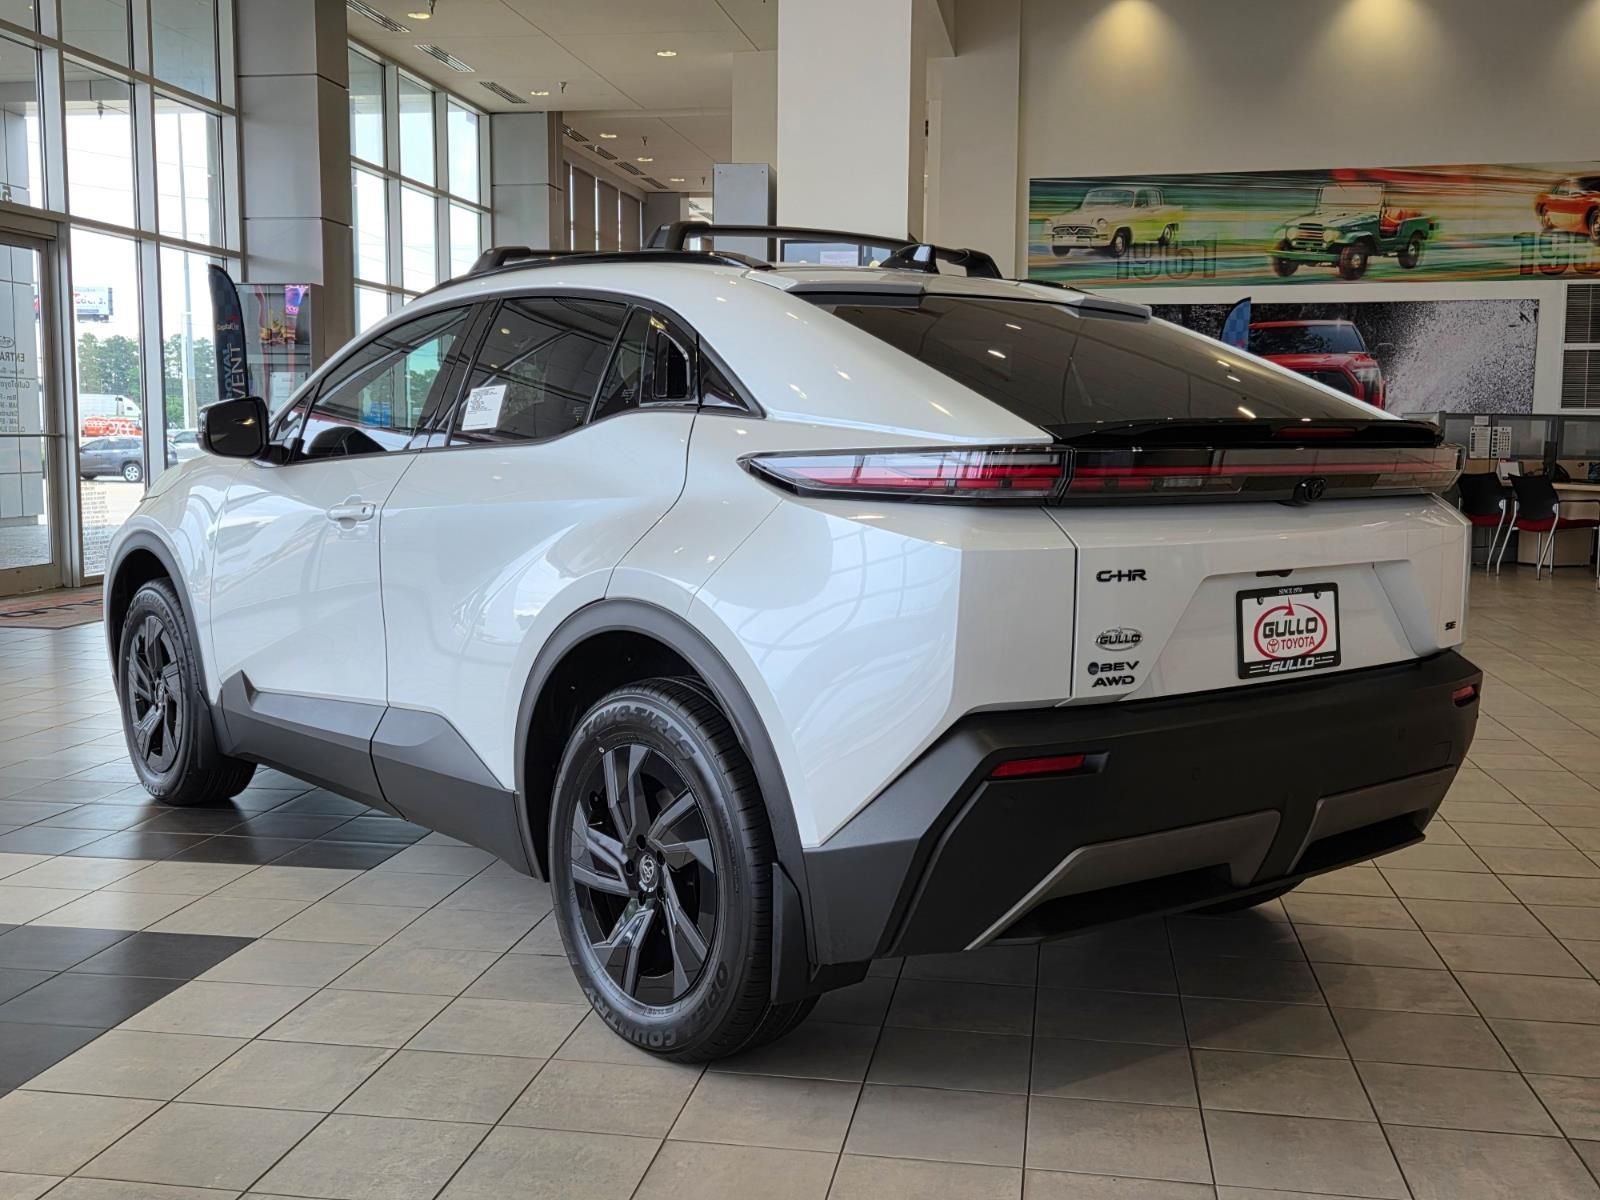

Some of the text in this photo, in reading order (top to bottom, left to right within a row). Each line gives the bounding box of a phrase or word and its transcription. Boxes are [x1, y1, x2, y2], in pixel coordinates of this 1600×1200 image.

[1096, 568, 1148, 583] C-HR
[1262, 617, 1318, 639] GULLO
[1099, 634, 1141, 645] GULLO
[1280, 635, 1316, 651] TOYOTA
[1100, 660, 1140, 673] BEV
[1268, 656, 1315, 673] GULLO
[1091, 674, 1136, 688] AWD
